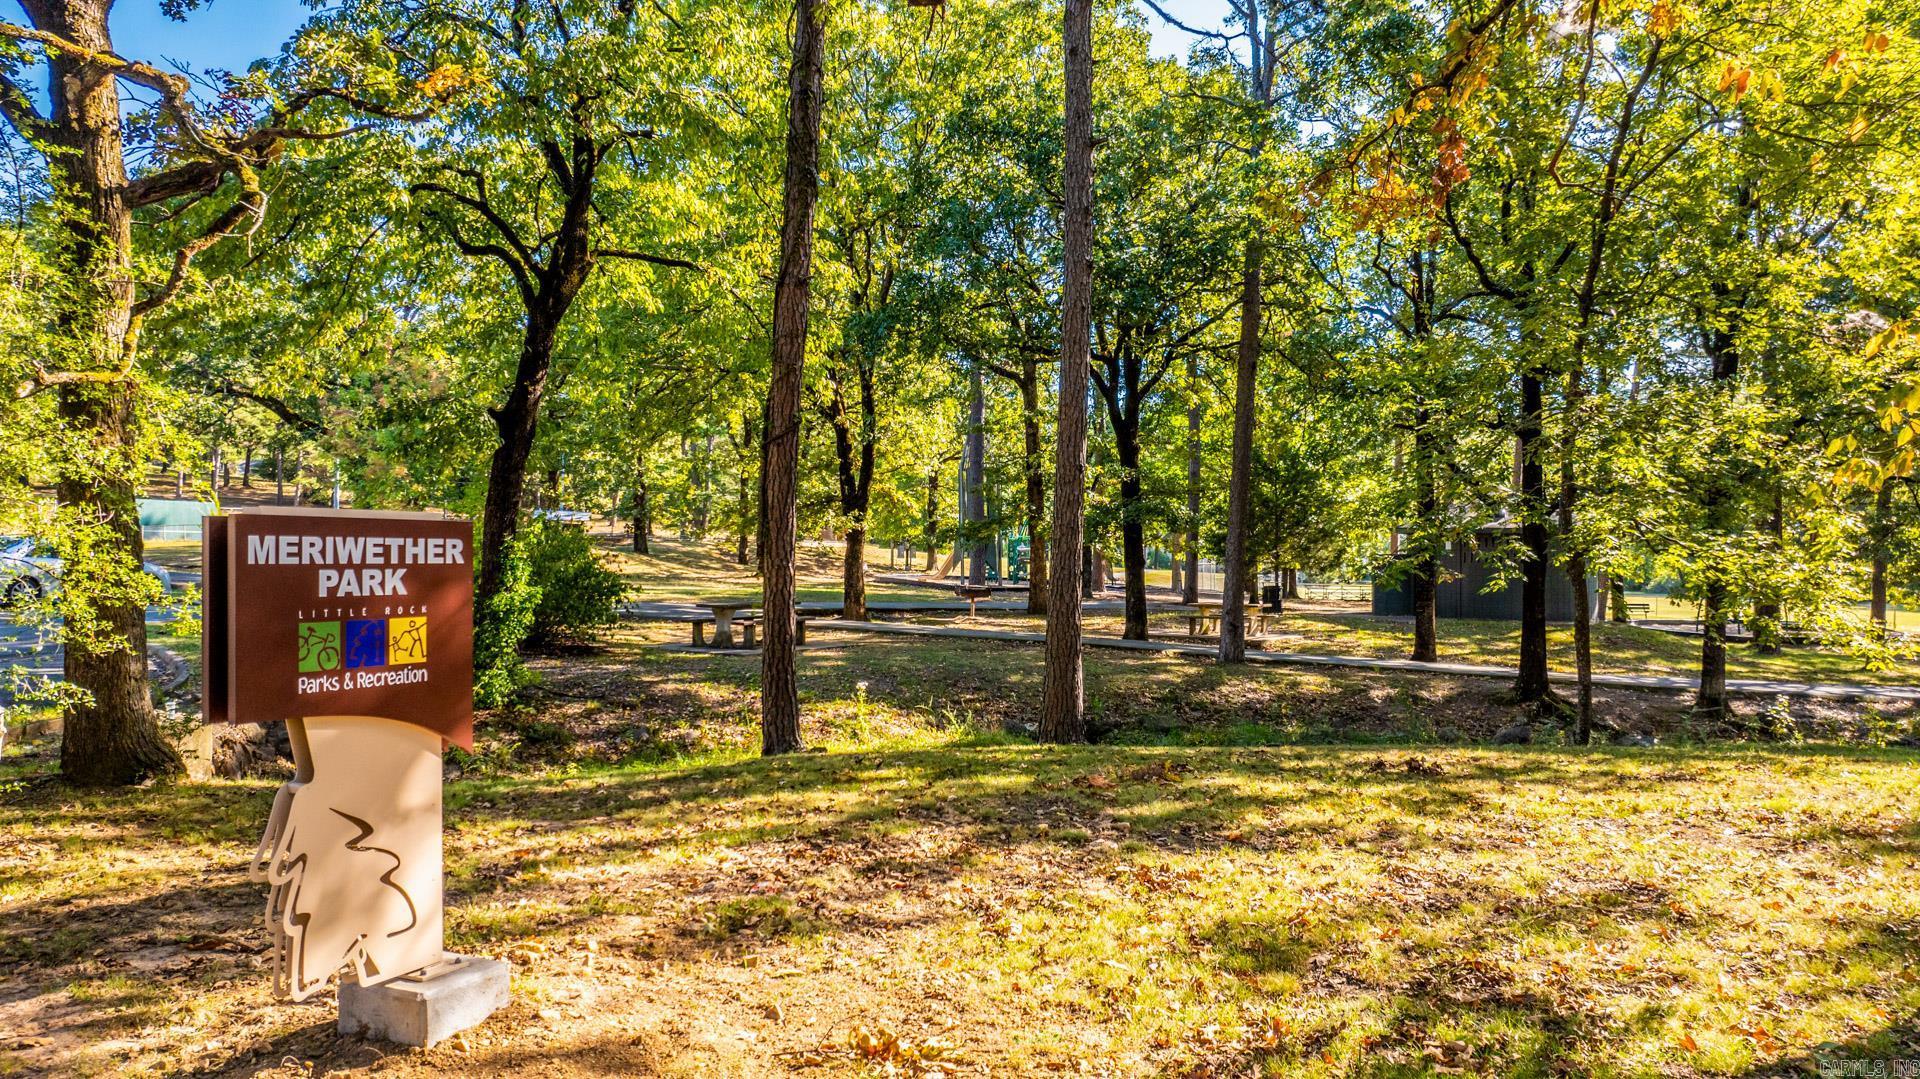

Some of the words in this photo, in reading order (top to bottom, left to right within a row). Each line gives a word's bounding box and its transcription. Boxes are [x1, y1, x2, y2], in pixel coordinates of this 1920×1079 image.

[247, 535, 464, 564] MERIWETHER
[318, 569, 407, 597] PARK
[299, 608, 367, 618] LITTLE
[385, 605, 427, 615] ROCK
[298, 675, 339, 694] Parks
[344, 673, 353, 689] &
[357, 666, 427, 688] Recreation
